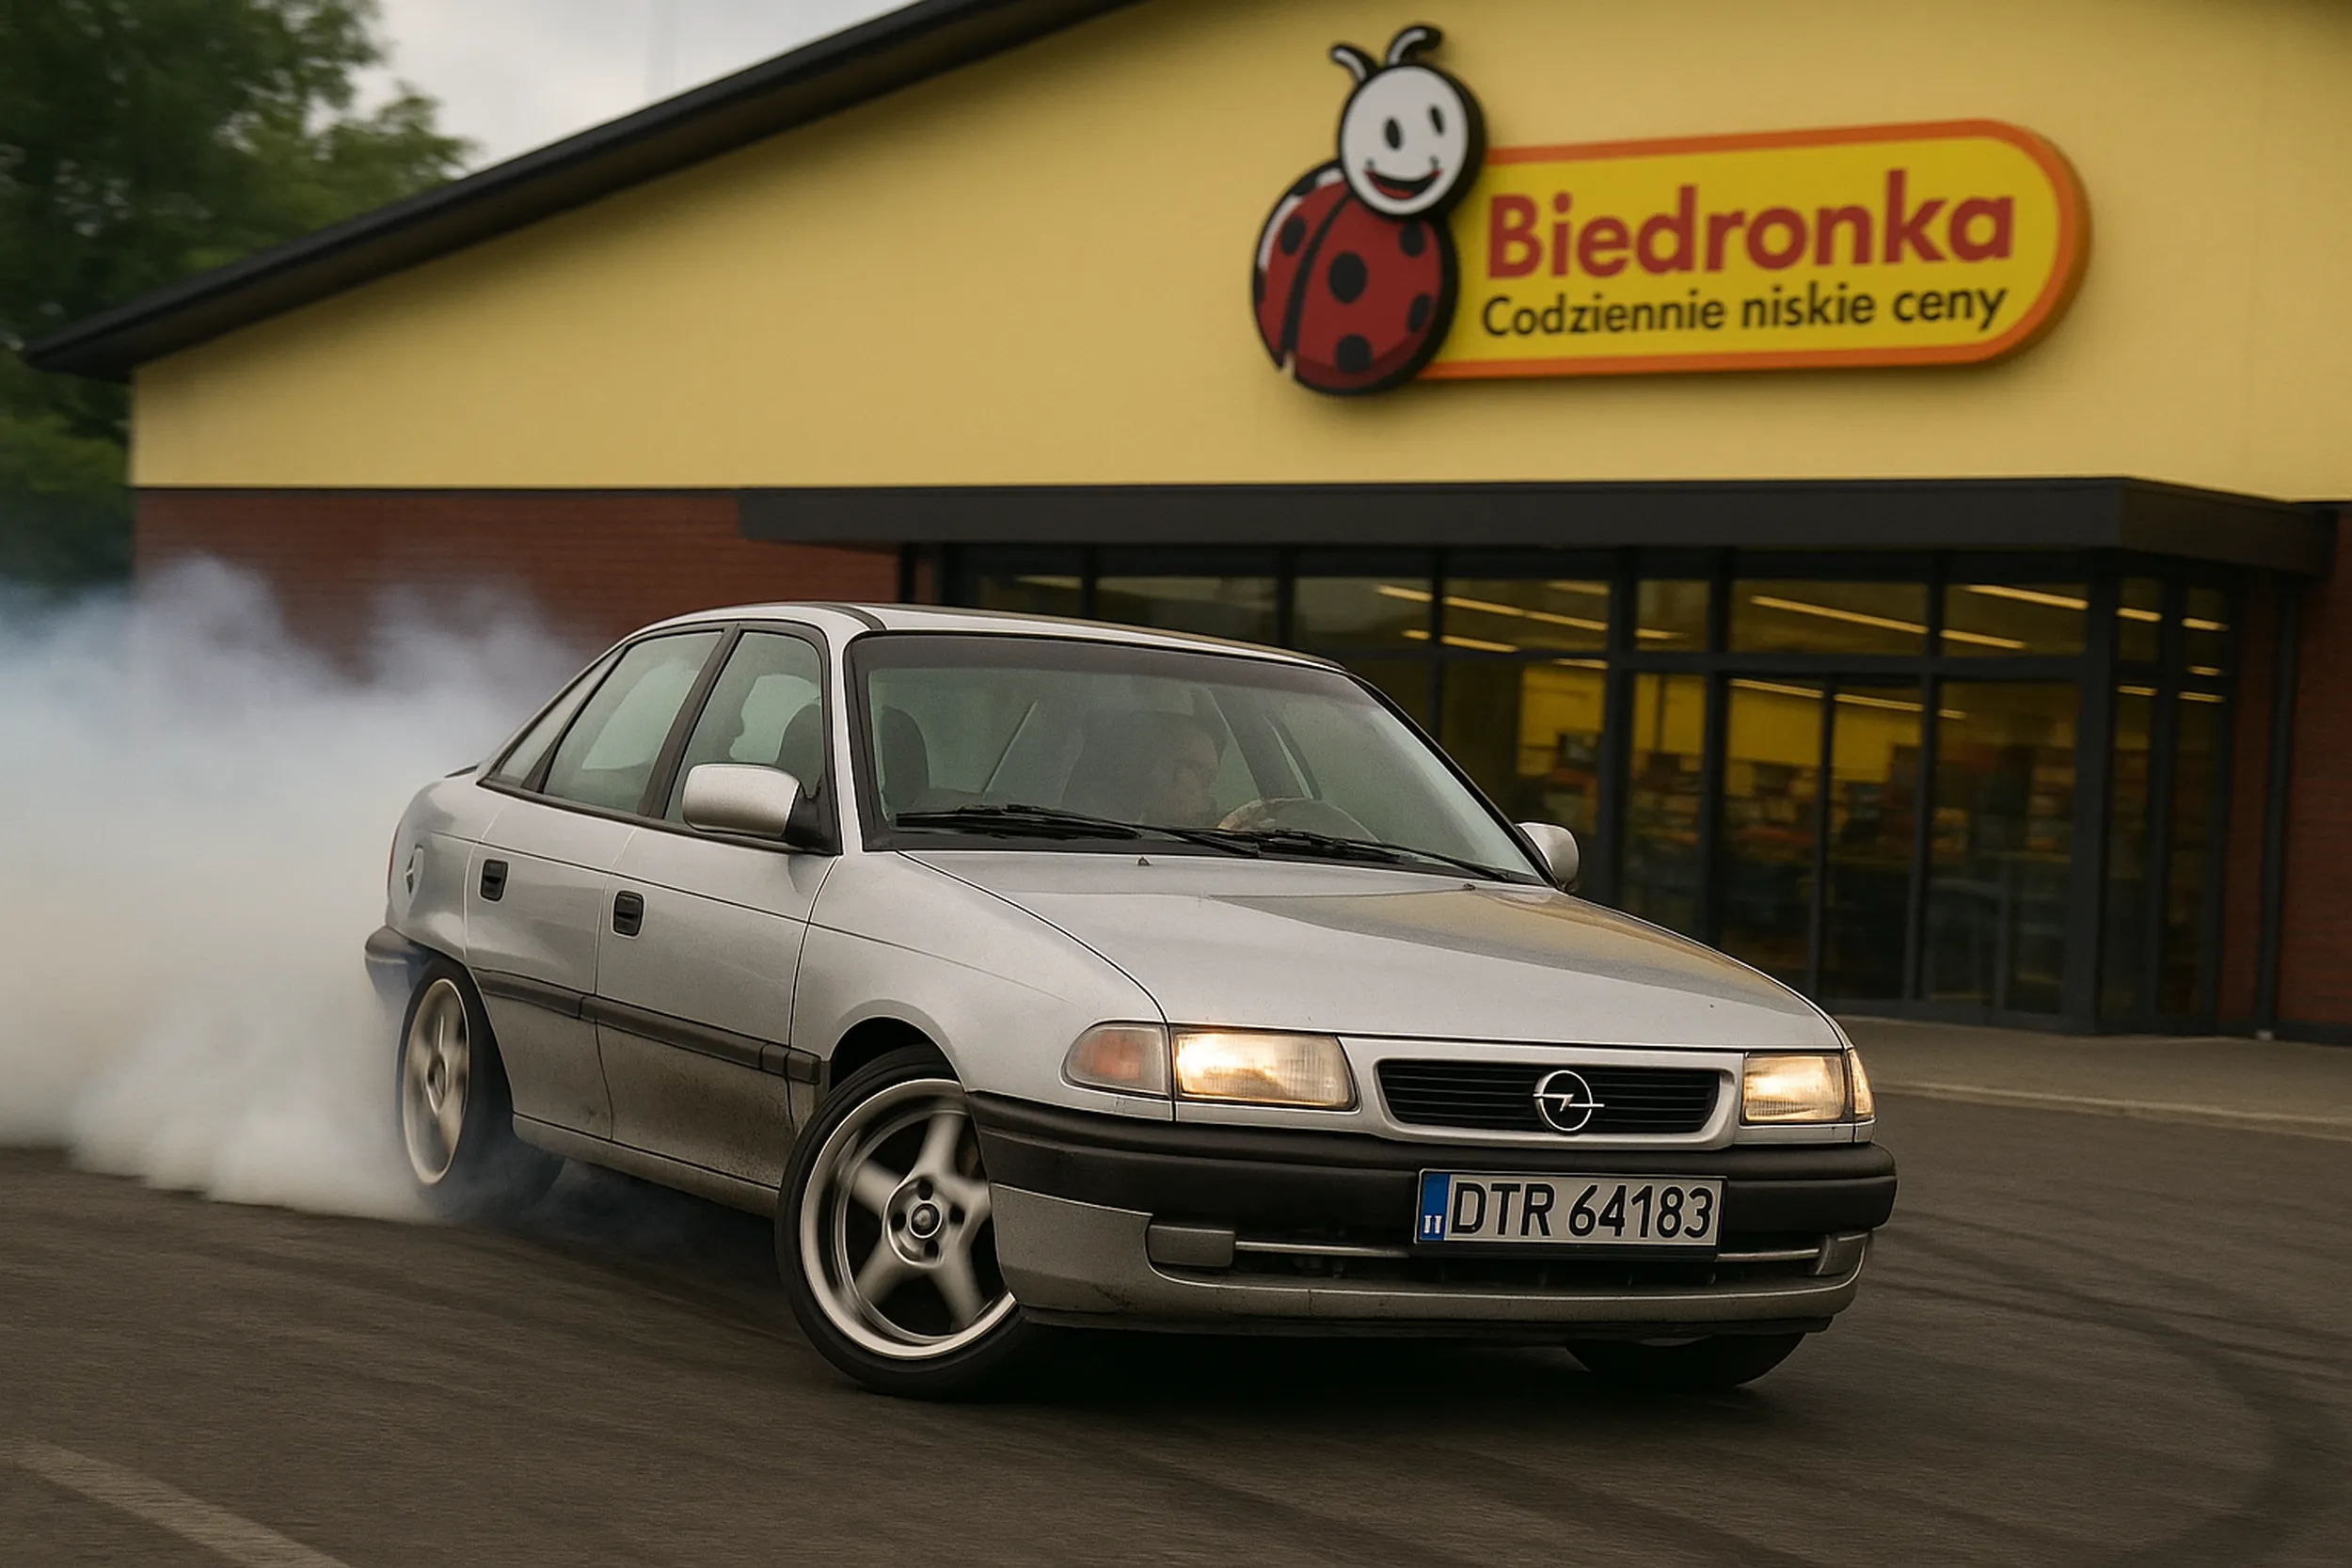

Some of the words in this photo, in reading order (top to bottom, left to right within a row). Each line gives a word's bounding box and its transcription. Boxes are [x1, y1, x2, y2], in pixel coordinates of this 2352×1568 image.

[1487, 168, 2014, 279] Biedronka
[1482, 288, 1725, 338] Codziennie
[1741, 281, 1875, 329] niskie
[1893, 285, 2008, 333] ceny
[1450, 1181, 1554, 1237] DTR
[1569, 1183, 1713, 1239] 64183
